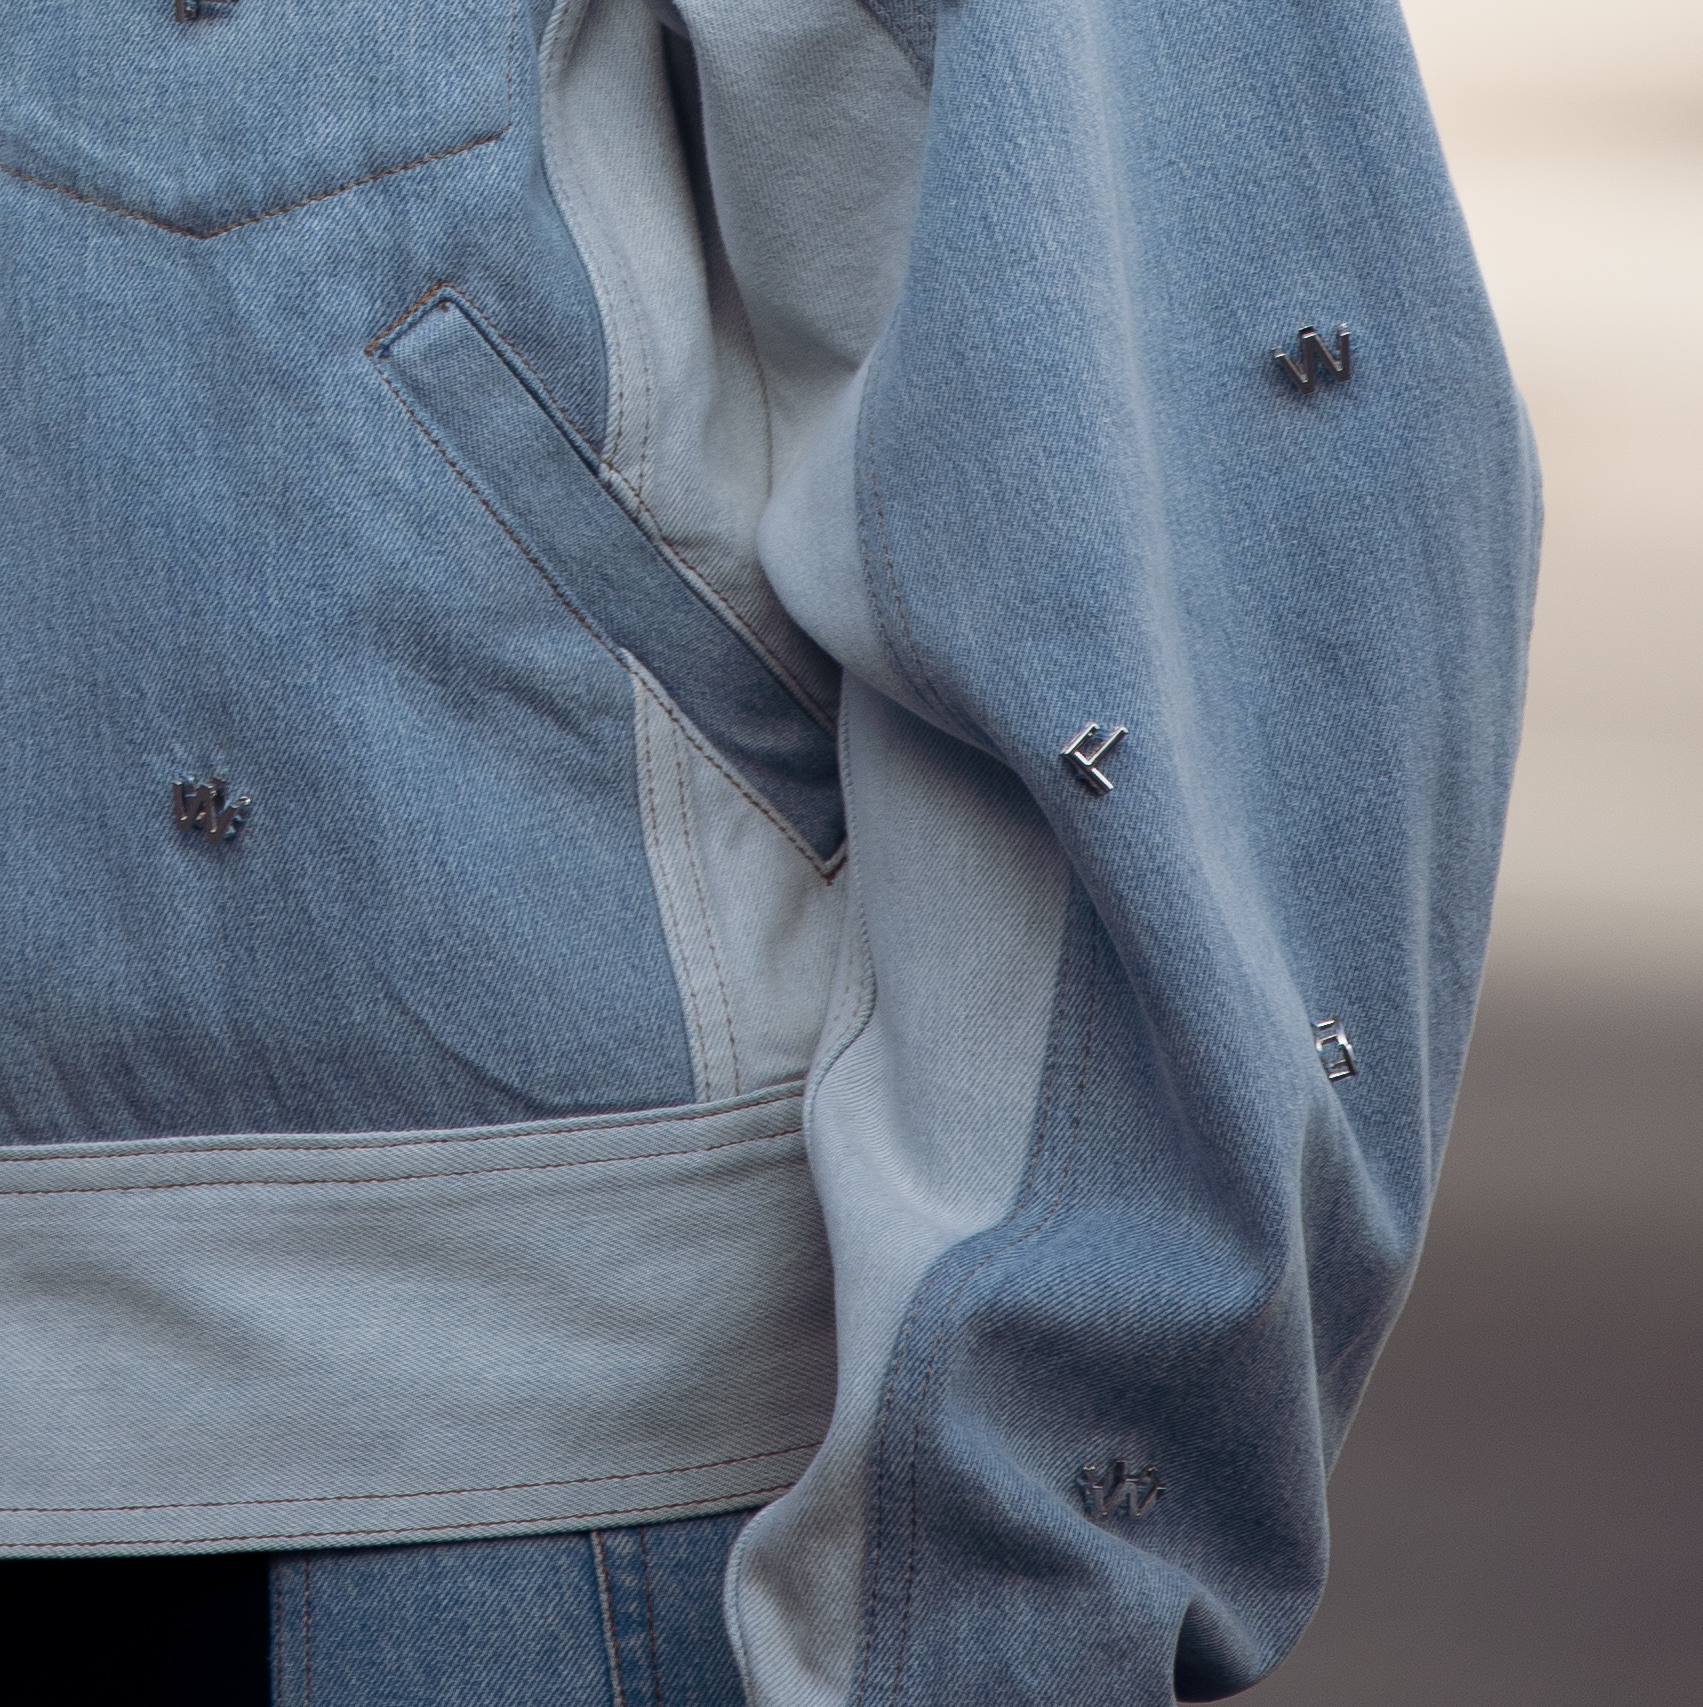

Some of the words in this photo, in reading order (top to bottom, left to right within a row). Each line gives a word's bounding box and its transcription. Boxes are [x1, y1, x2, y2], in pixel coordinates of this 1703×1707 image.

[1271, 323, 1352, 394] W
[1060, 722, 1129, 793] F
[171, 777, 251, 845] W
